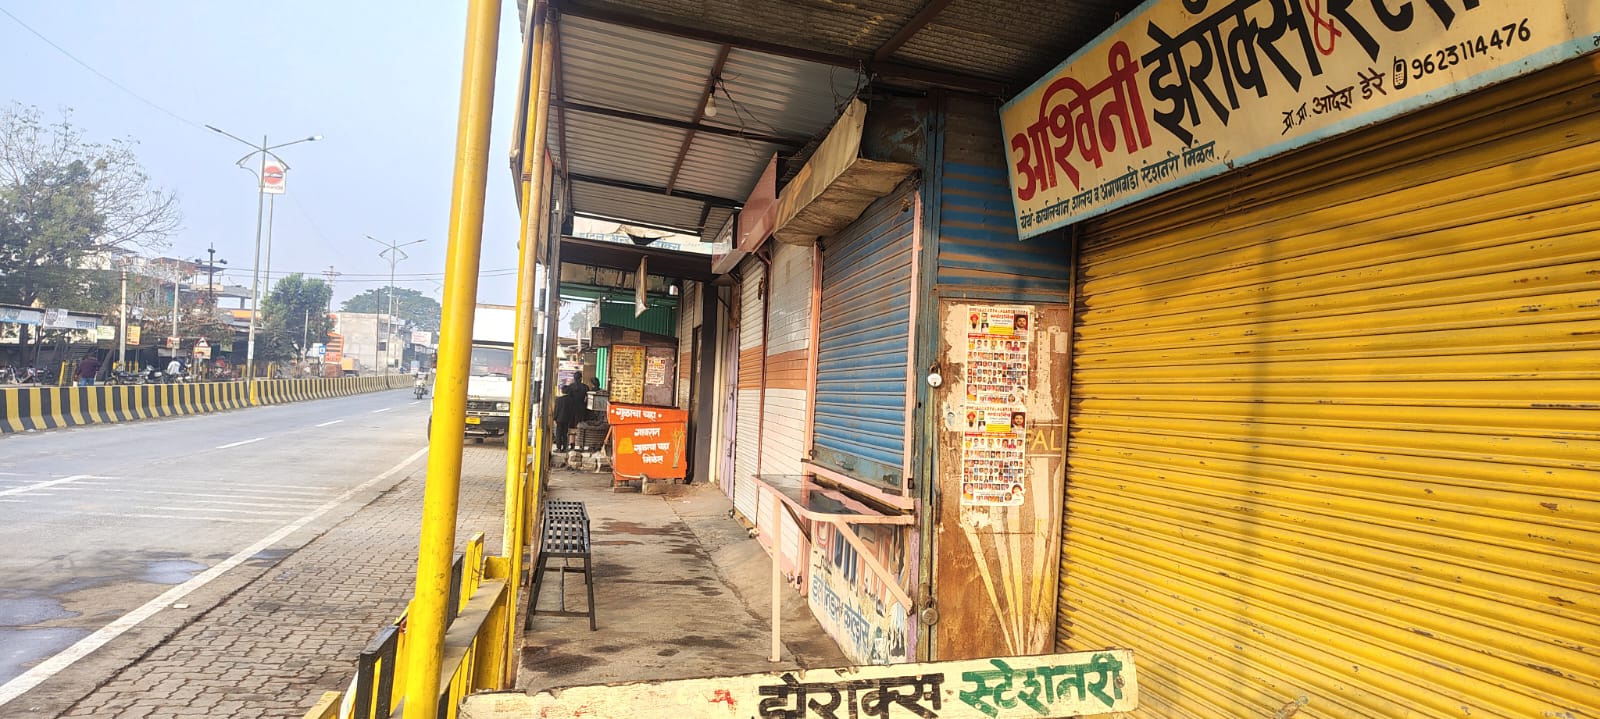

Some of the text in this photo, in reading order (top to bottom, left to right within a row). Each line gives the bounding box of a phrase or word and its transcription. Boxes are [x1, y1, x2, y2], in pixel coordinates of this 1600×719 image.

[1312, 85, 1354, 114] आदेश
[1357, 67, 1387, 99] डेरे
[1411, 18, 1531, 79] 9623114476
[1011, 41, 1152, 201] अश्विनी
[1100, 165, 1138, 201] अंगणवाडी
[1140, 150, 1180, 184] स्टेशनरी
[959, 653, 1123, 719] स्टेशनरी
